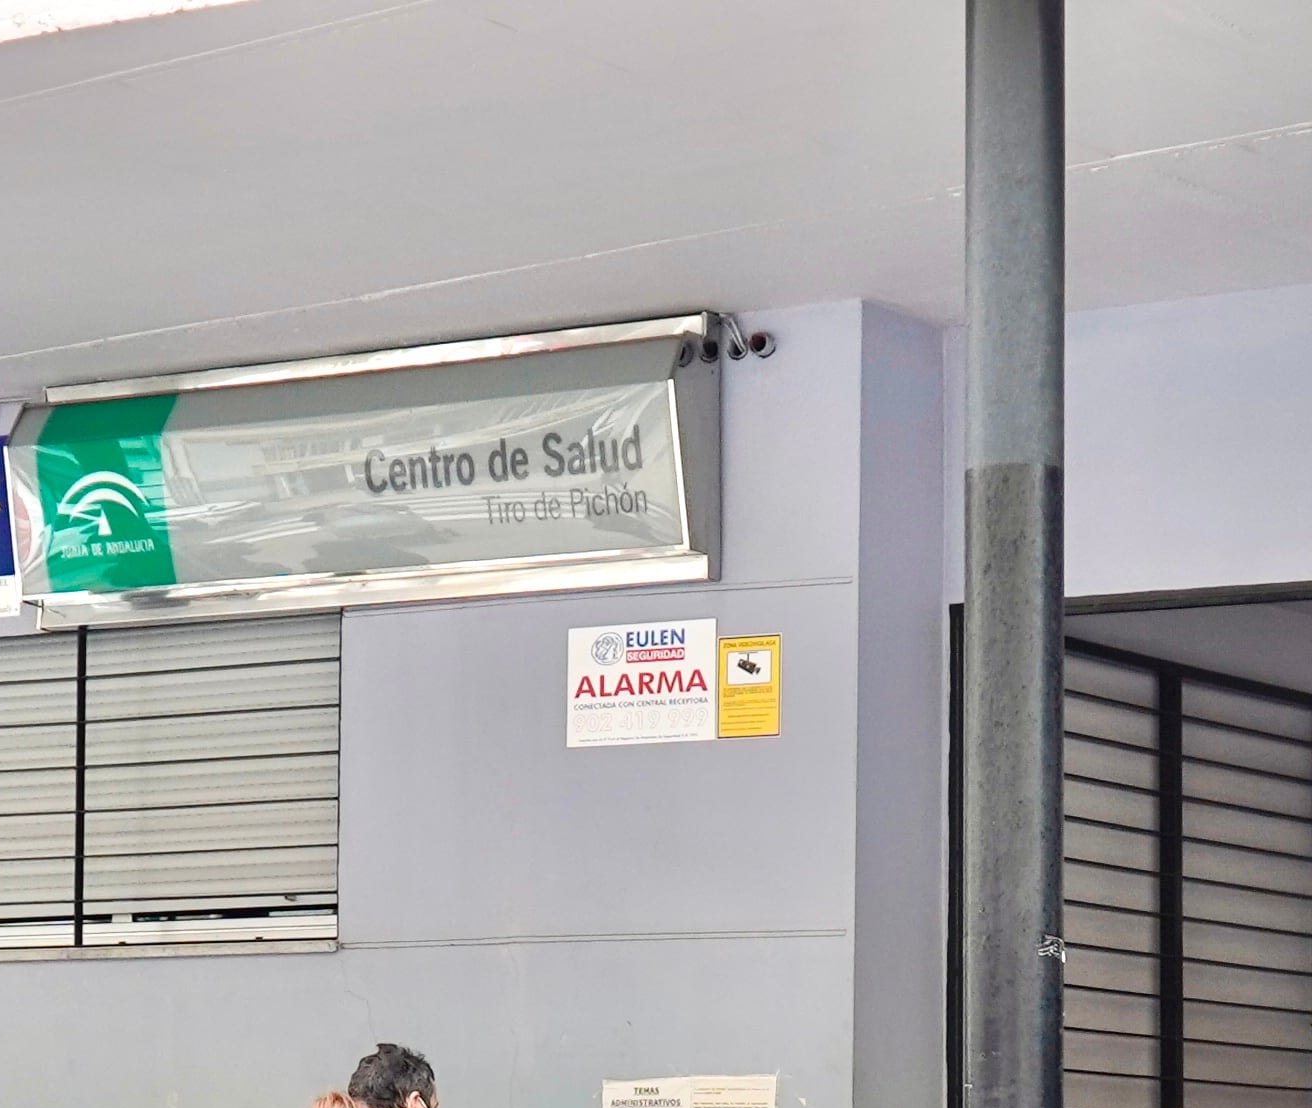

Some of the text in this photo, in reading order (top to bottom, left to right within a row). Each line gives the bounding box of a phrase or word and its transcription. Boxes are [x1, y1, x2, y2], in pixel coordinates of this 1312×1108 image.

[364, 424, 643, 494] Centro de Salud
[482, 483, 648, 525] Tiro de Pichón
[91, 542, 103, 556] DE
[0, 579, 9, 587] EL
[625, 628, 686, 648] EULEN
[626, 648, 685, 662] SEGURIDAD
[574, 668, 708, 699] ALARMA
[574, 696, 709, 711] CONECTADA CON CENTRAL RECEPTORA
[633, 1086, 660, 1096] TEMAS
[610, 1098, 681, 1107] ADMINISTRATIVOS
